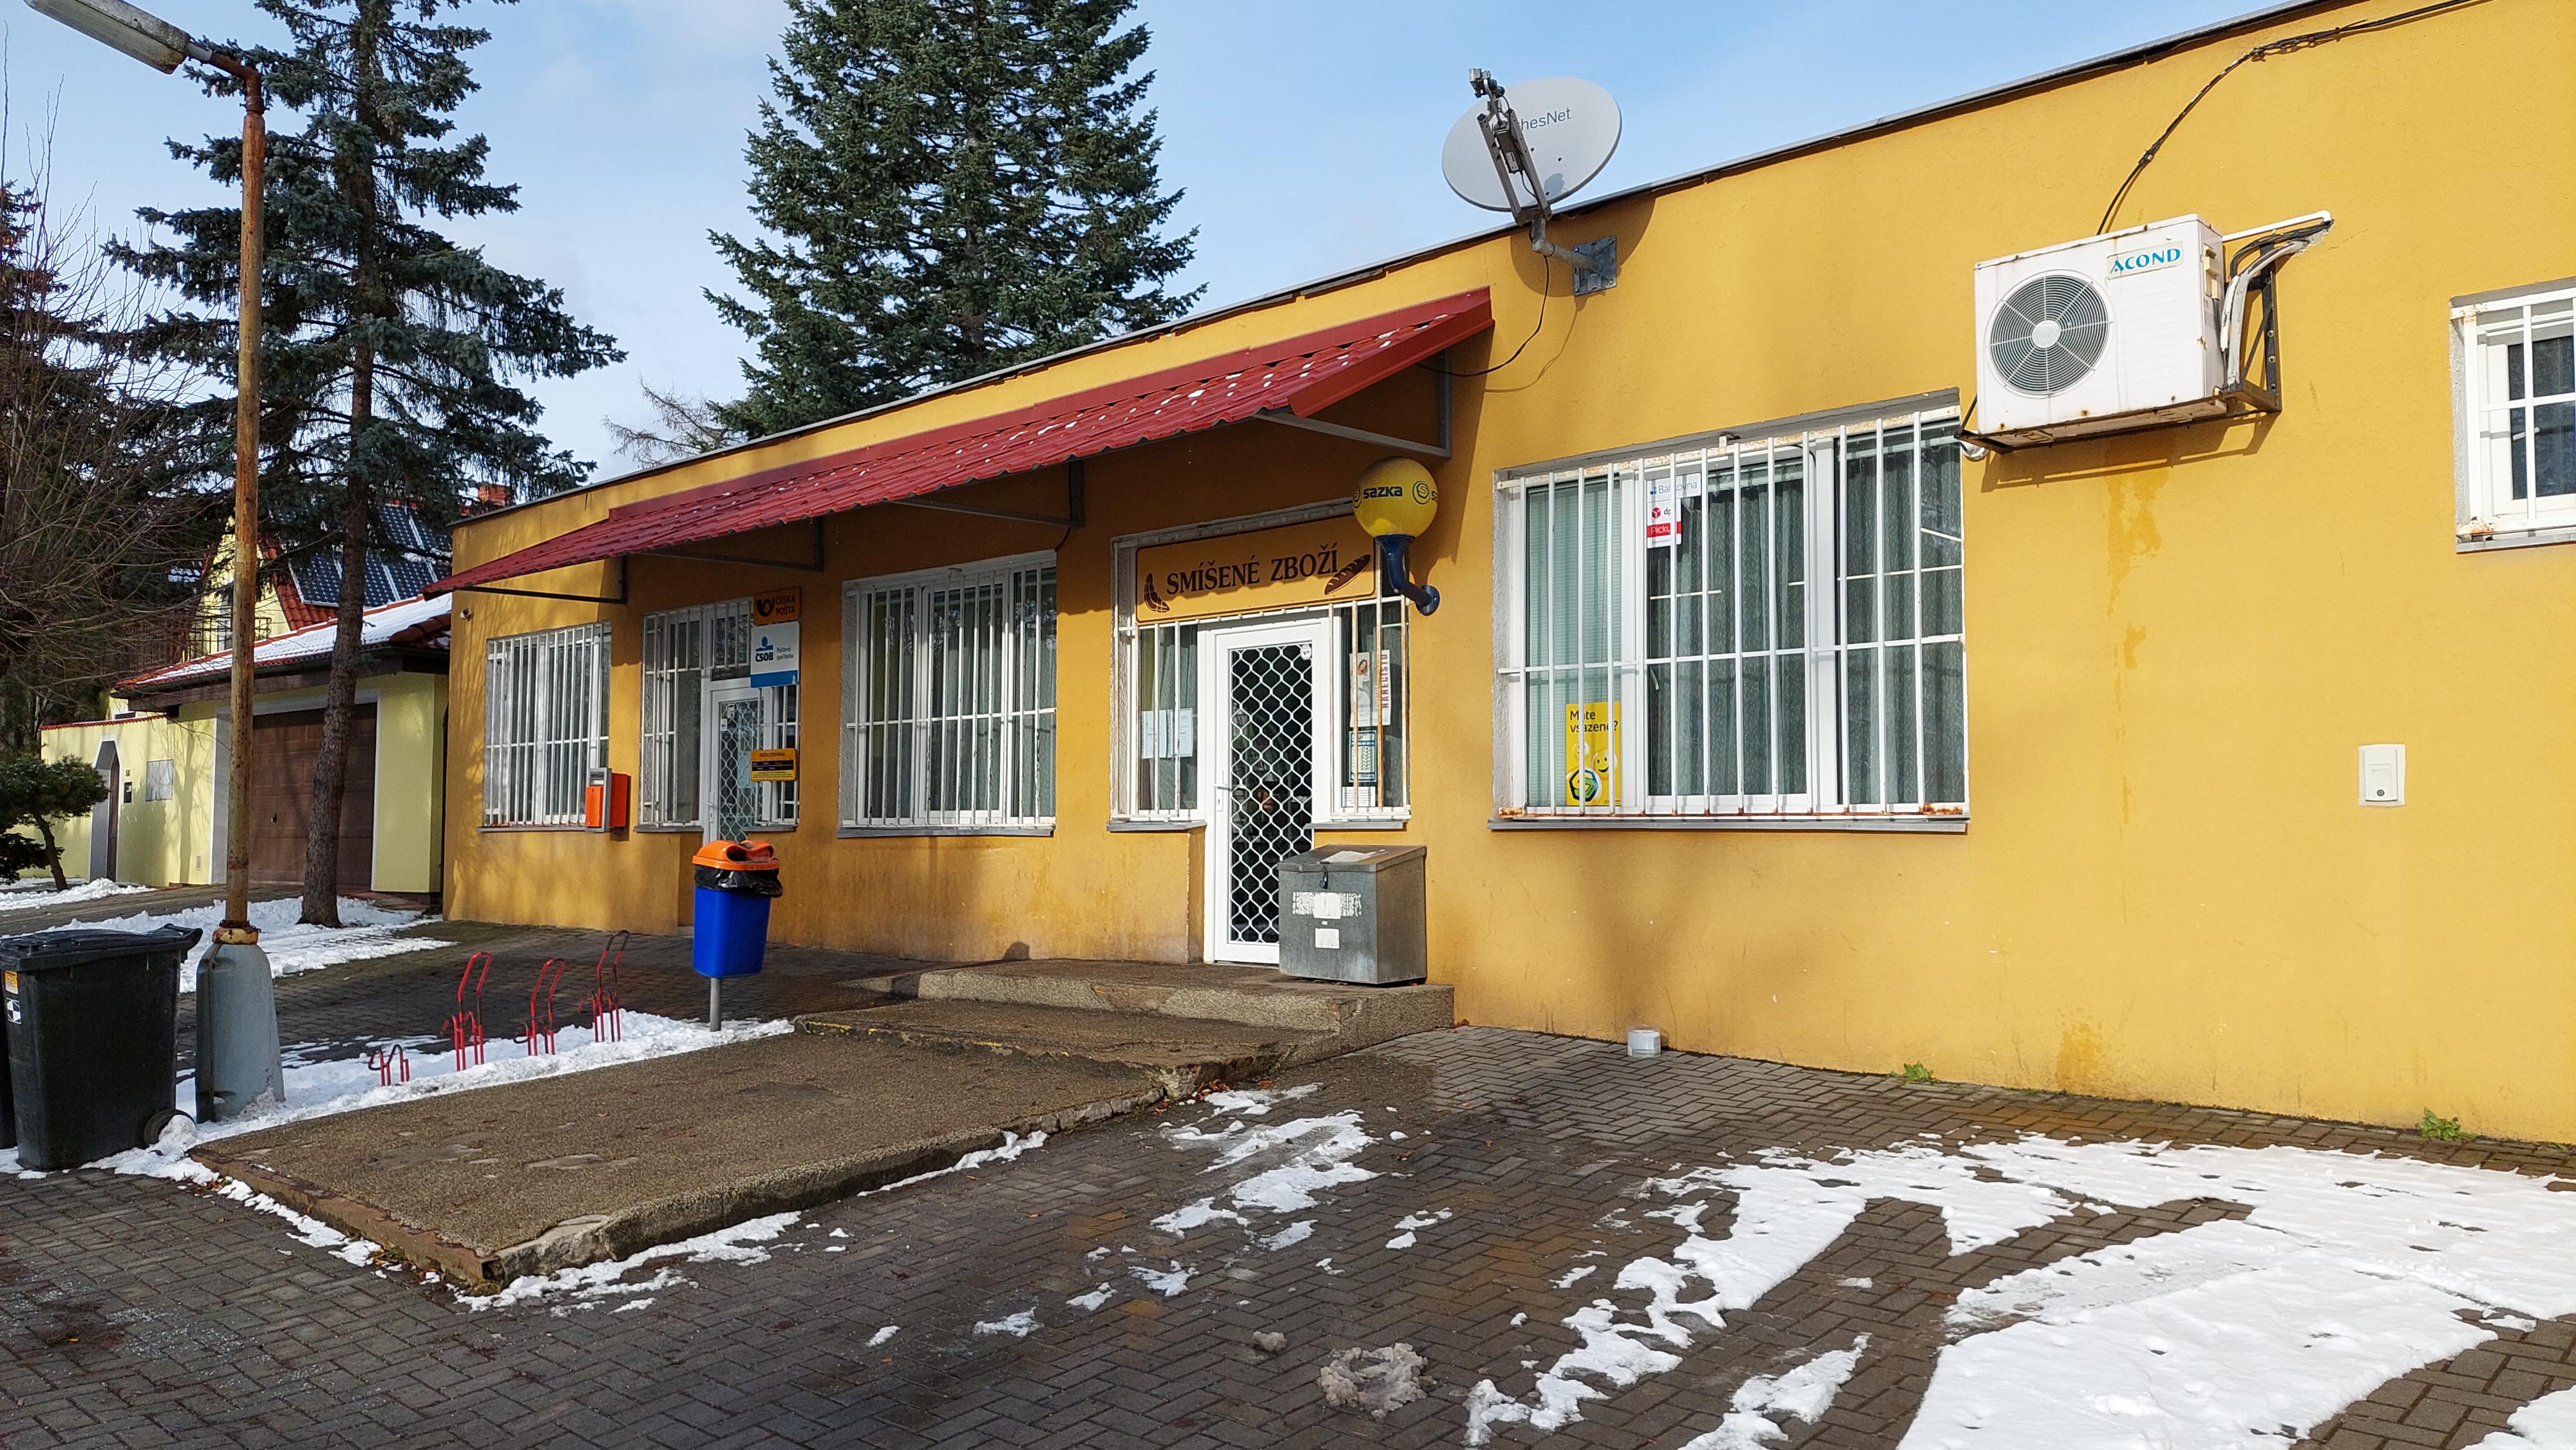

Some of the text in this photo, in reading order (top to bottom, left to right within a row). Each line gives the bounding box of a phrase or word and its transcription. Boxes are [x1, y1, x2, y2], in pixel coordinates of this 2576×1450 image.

[2110, 248, 2181, 274] ACOND
[1363, 486, 1403, 500] sazka
[1166, 542, 1338, 595] SMÍŠENÉ ZBOŽÍ
[755, 652, 773, 662] ČSOB
[1570, 710, 1596, 720] Mte
